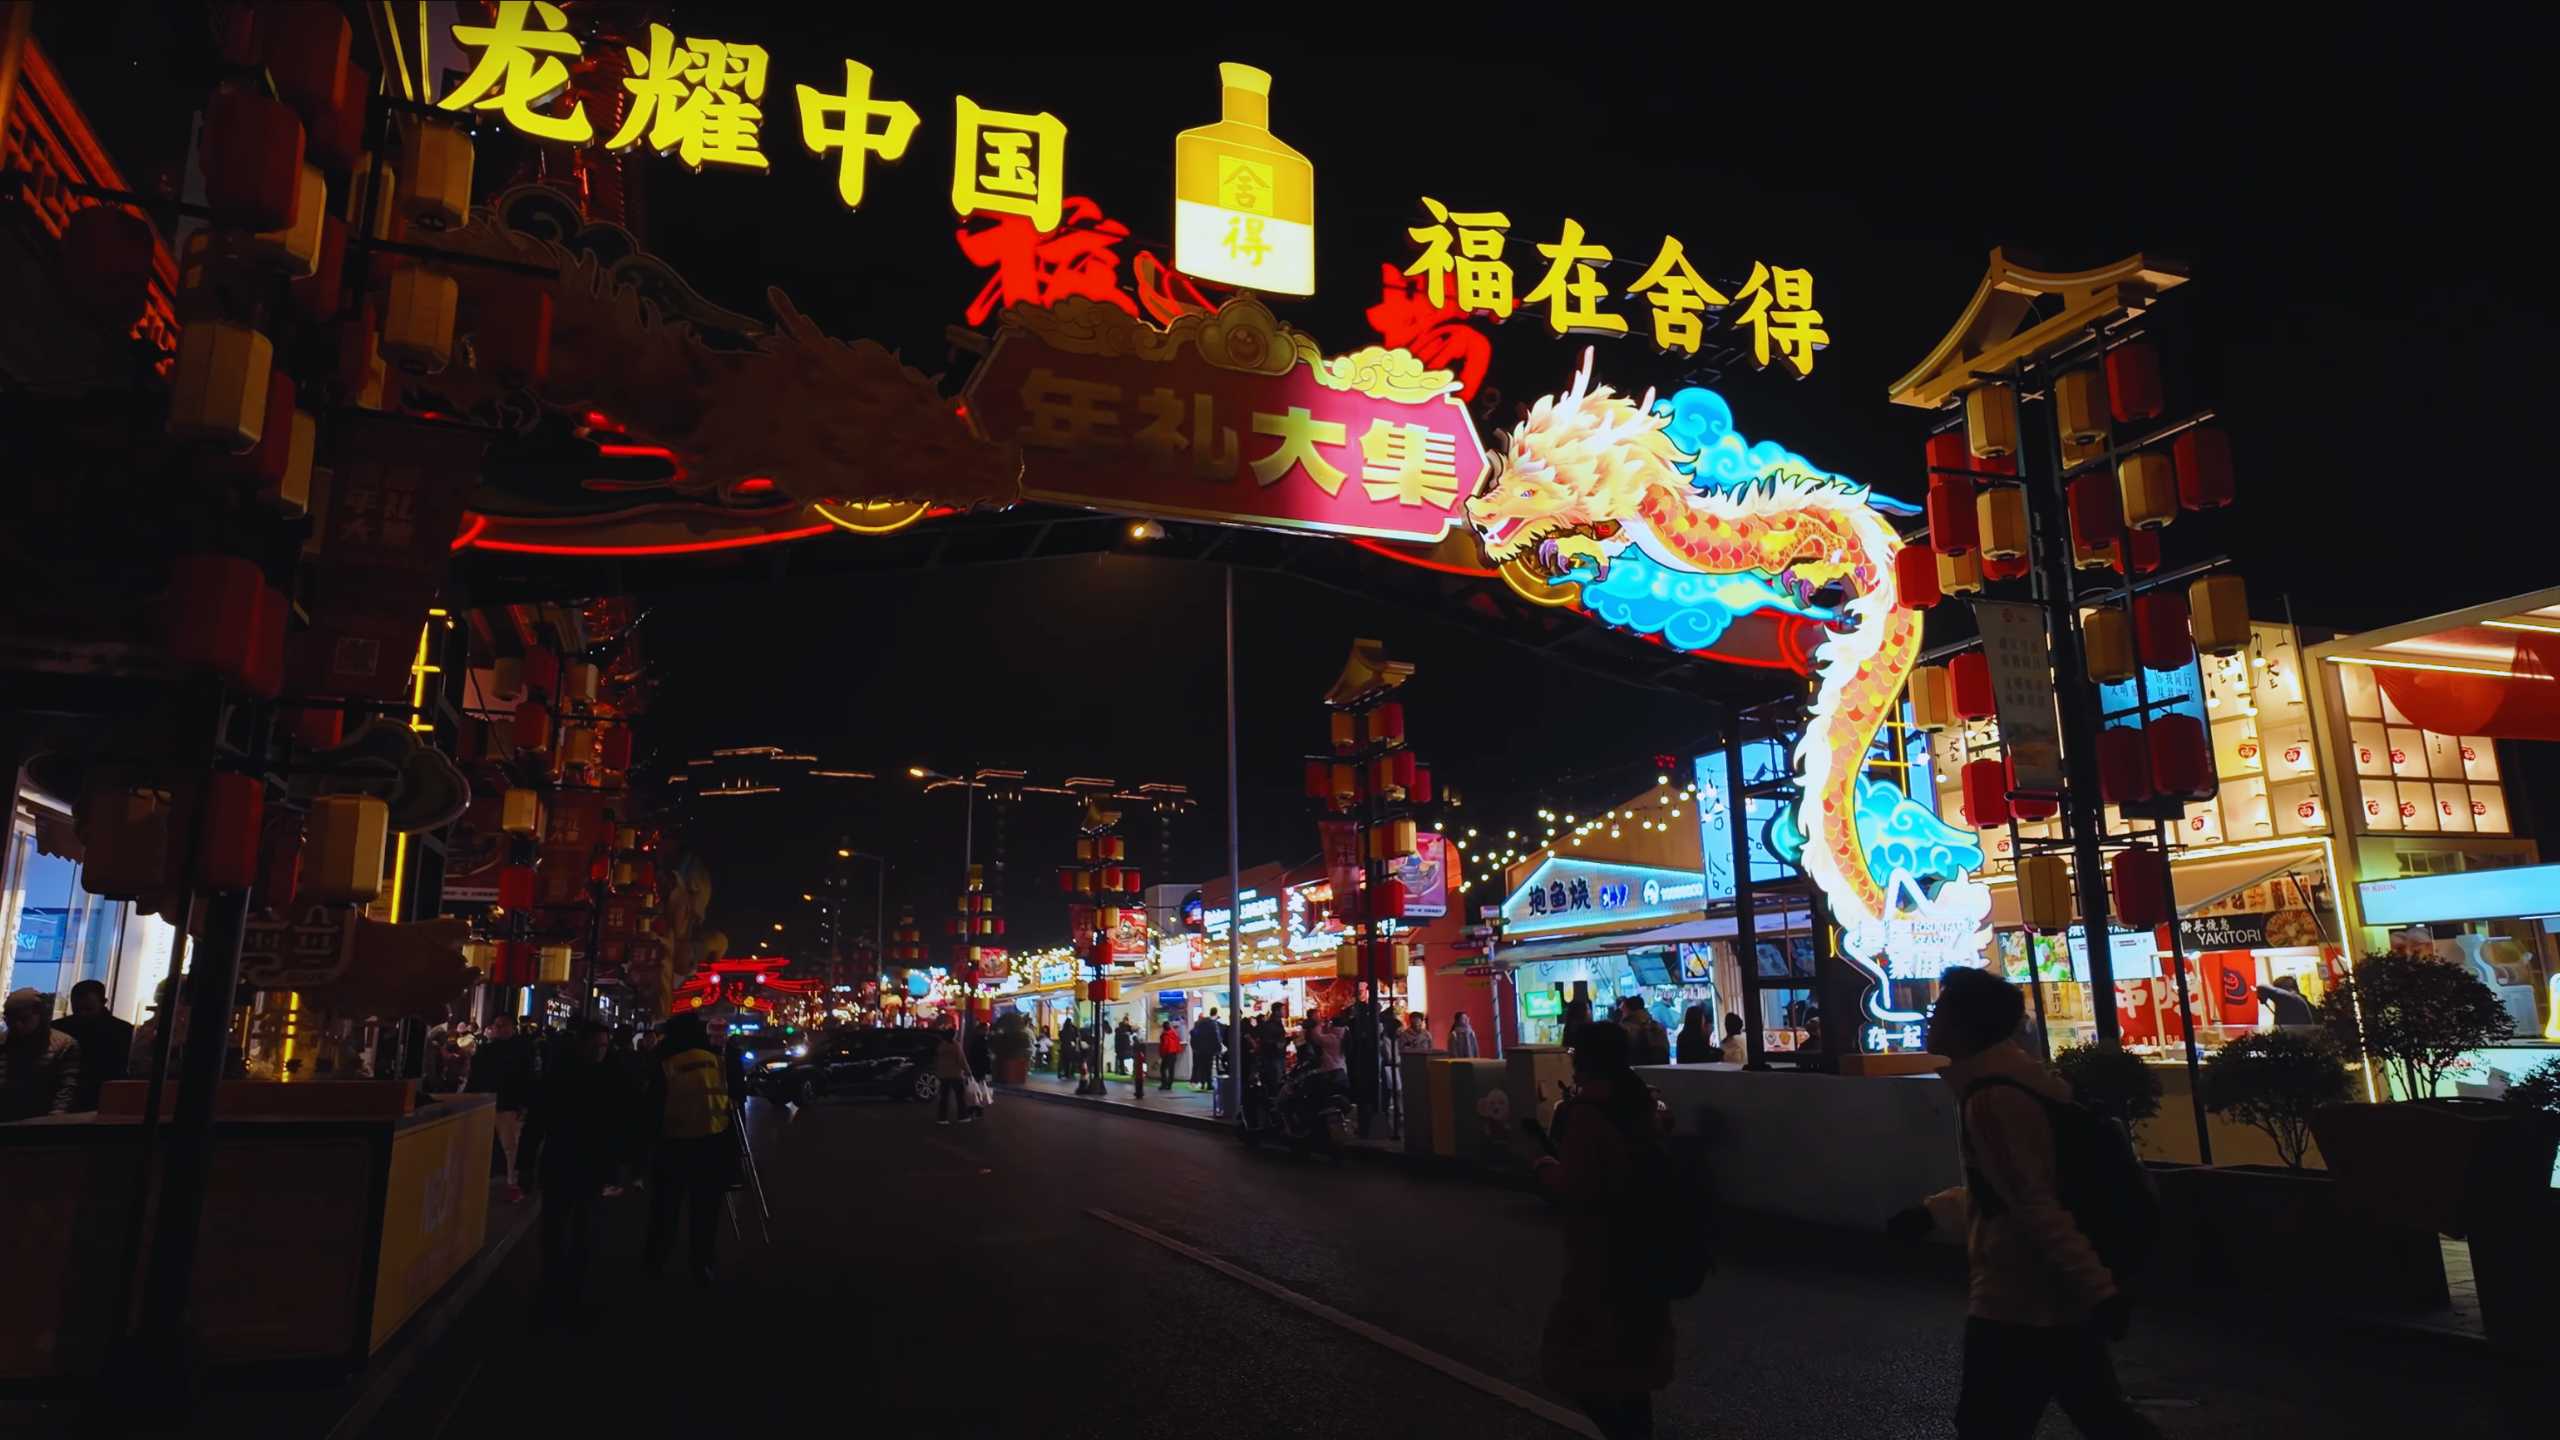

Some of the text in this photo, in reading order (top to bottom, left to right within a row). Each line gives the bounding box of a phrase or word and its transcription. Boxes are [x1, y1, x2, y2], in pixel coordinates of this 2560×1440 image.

[437, 0, 1068, 233] 龙耀中国
[1220, 164, 1273, 269] 舍得
[1403, 196, 1831, 378] 福在舍得
[1018, 369, 1460, 511] 年礼大集
[2196, 928, 2262, 947] YAKITORI
